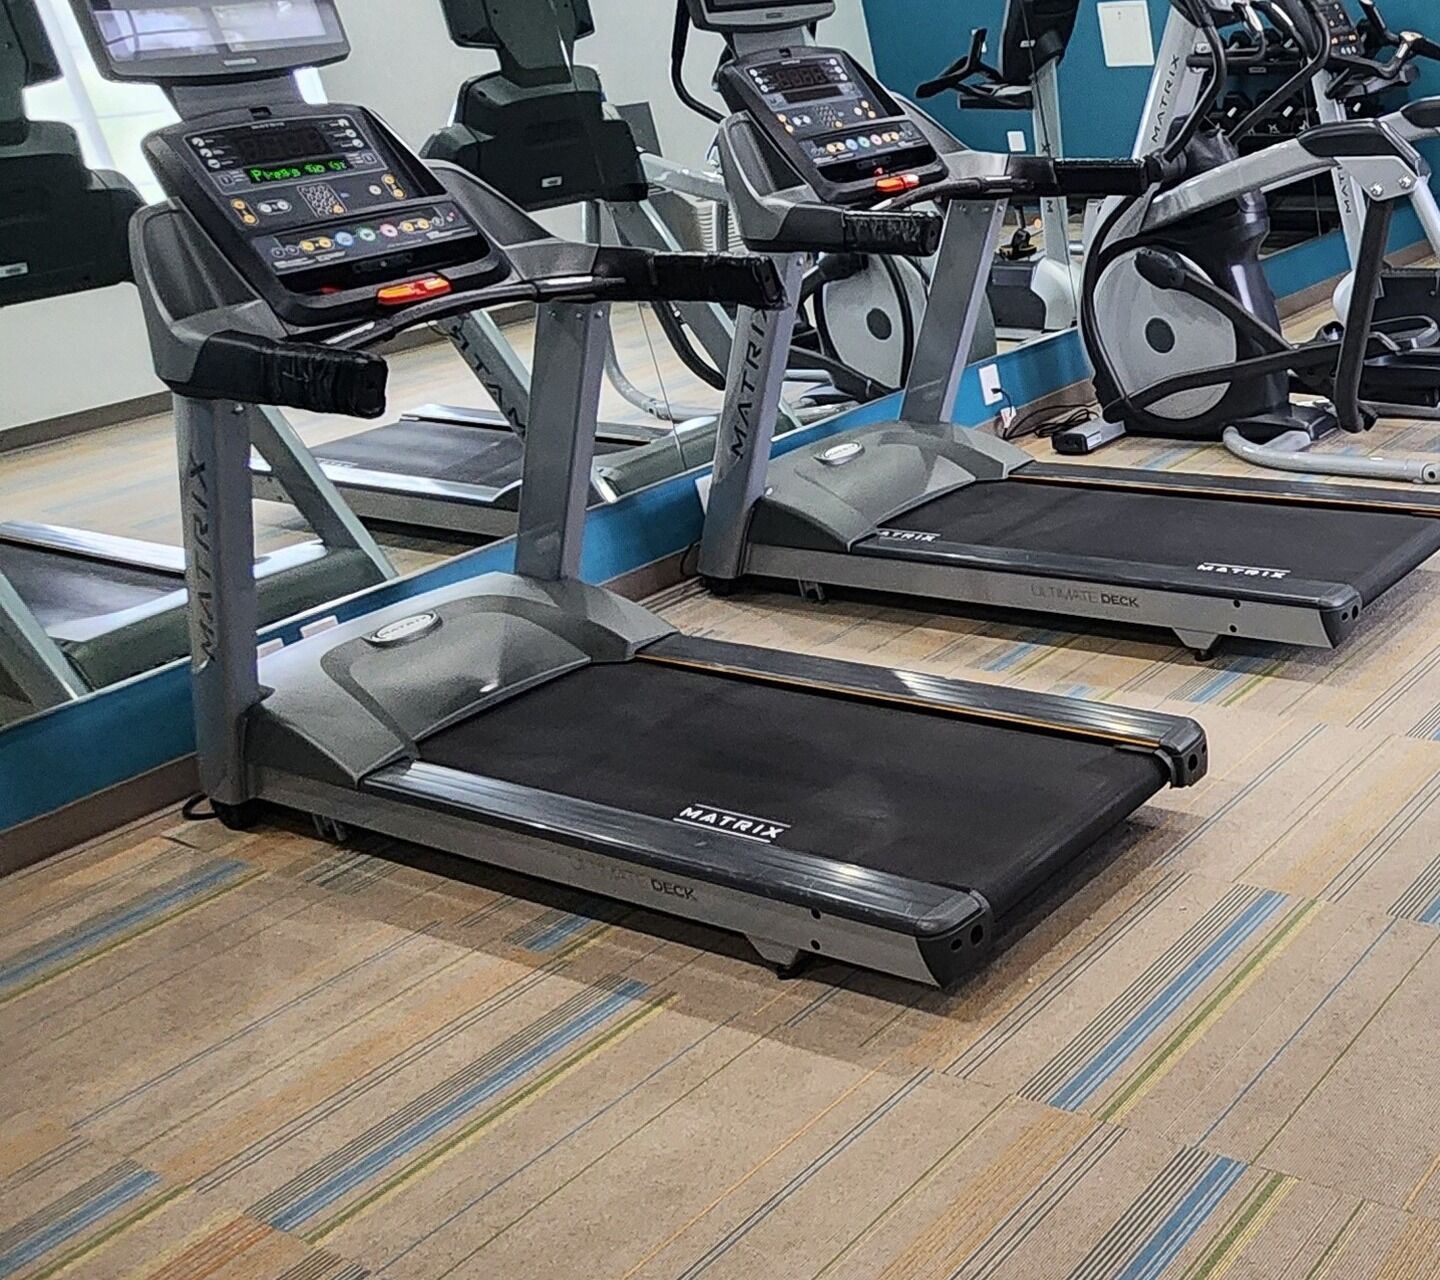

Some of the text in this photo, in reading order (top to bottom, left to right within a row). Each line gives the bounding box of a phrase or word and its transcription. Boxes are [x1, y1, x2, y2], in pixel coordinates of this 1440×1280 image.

[1151, 54, 1179, 143] MATRIX
[879, 530, 937, 542] ATRIX
[190, 452, 216, 662] MATRIX
[1196, 563, 1287, 580] MATRIX
[1101, 593, 1140, 608] DECK
[679, 807, 784, 839] MATRIX
[650, 878, 698, 901] DECK
